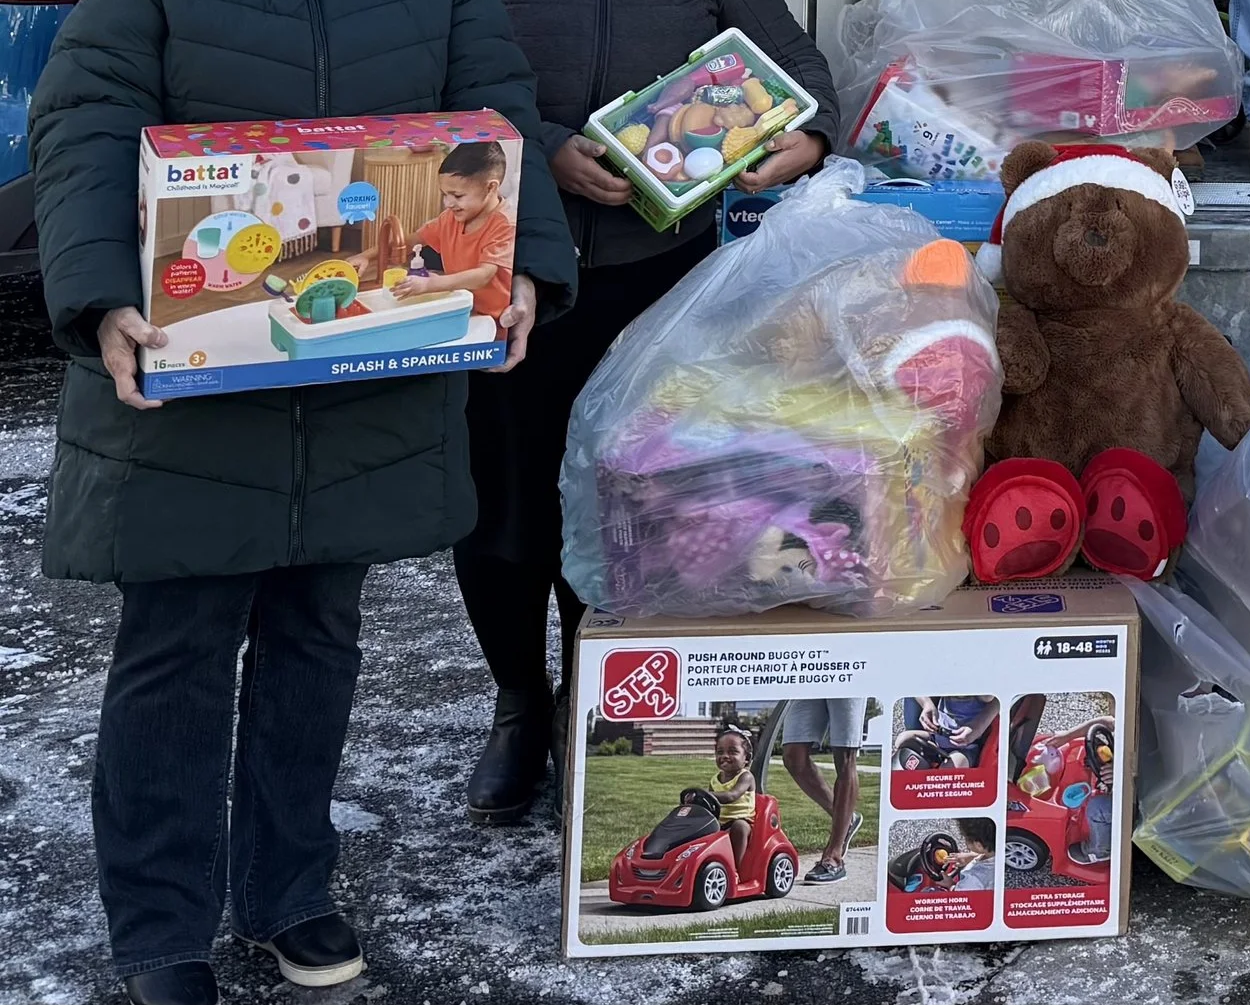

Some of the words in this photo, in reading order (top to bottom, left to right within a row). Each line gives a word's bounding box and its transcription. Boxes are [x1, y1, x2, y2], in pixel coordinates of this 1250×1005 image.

[297, 124, 366, 133] battat
[167, 164, 240, 183] battat
[166, 184, 201, 192] Childhood
[340, 194, 377, 204] WORKING
[153, 360, 167, 370] 16
[331, 359, 384, 375] SPLASH
[388, 359, 398, 369] &
[401, 352, 460, 368] SPARKLE
[1056, 641, 1093, 654] 18-48
[688, 653, 717, 662] PUSH
[720, 652, 765, 661] AROUND
[768, 651, 806, 661] BUGGY
[687, 664, 738, 674] PORTEUR
[740, 663, 788, 673] CHARIOT
[790, 660, 799, 672] À
[800, 662, 850, 672] POUSSER
[853, 661, 867, 670] GT
[605, 652, 670, 715] STEP
[687, 676, 735, 686] CARRITO
[737, 676, 751, 685] DE
[753, 675, 797, 685] EMPUJE
[799, 674, 836, 684] BUGGY
[839, 673, 853, 683] GT
[905, 783, 951, 791] AJUSTEMENT
[945, 912, 976, 920] TRABAJO
[1007, 909, 1070, 917] ALMACENAMIENTO
[1071, 907, 1108, 915] ADICIONAL
